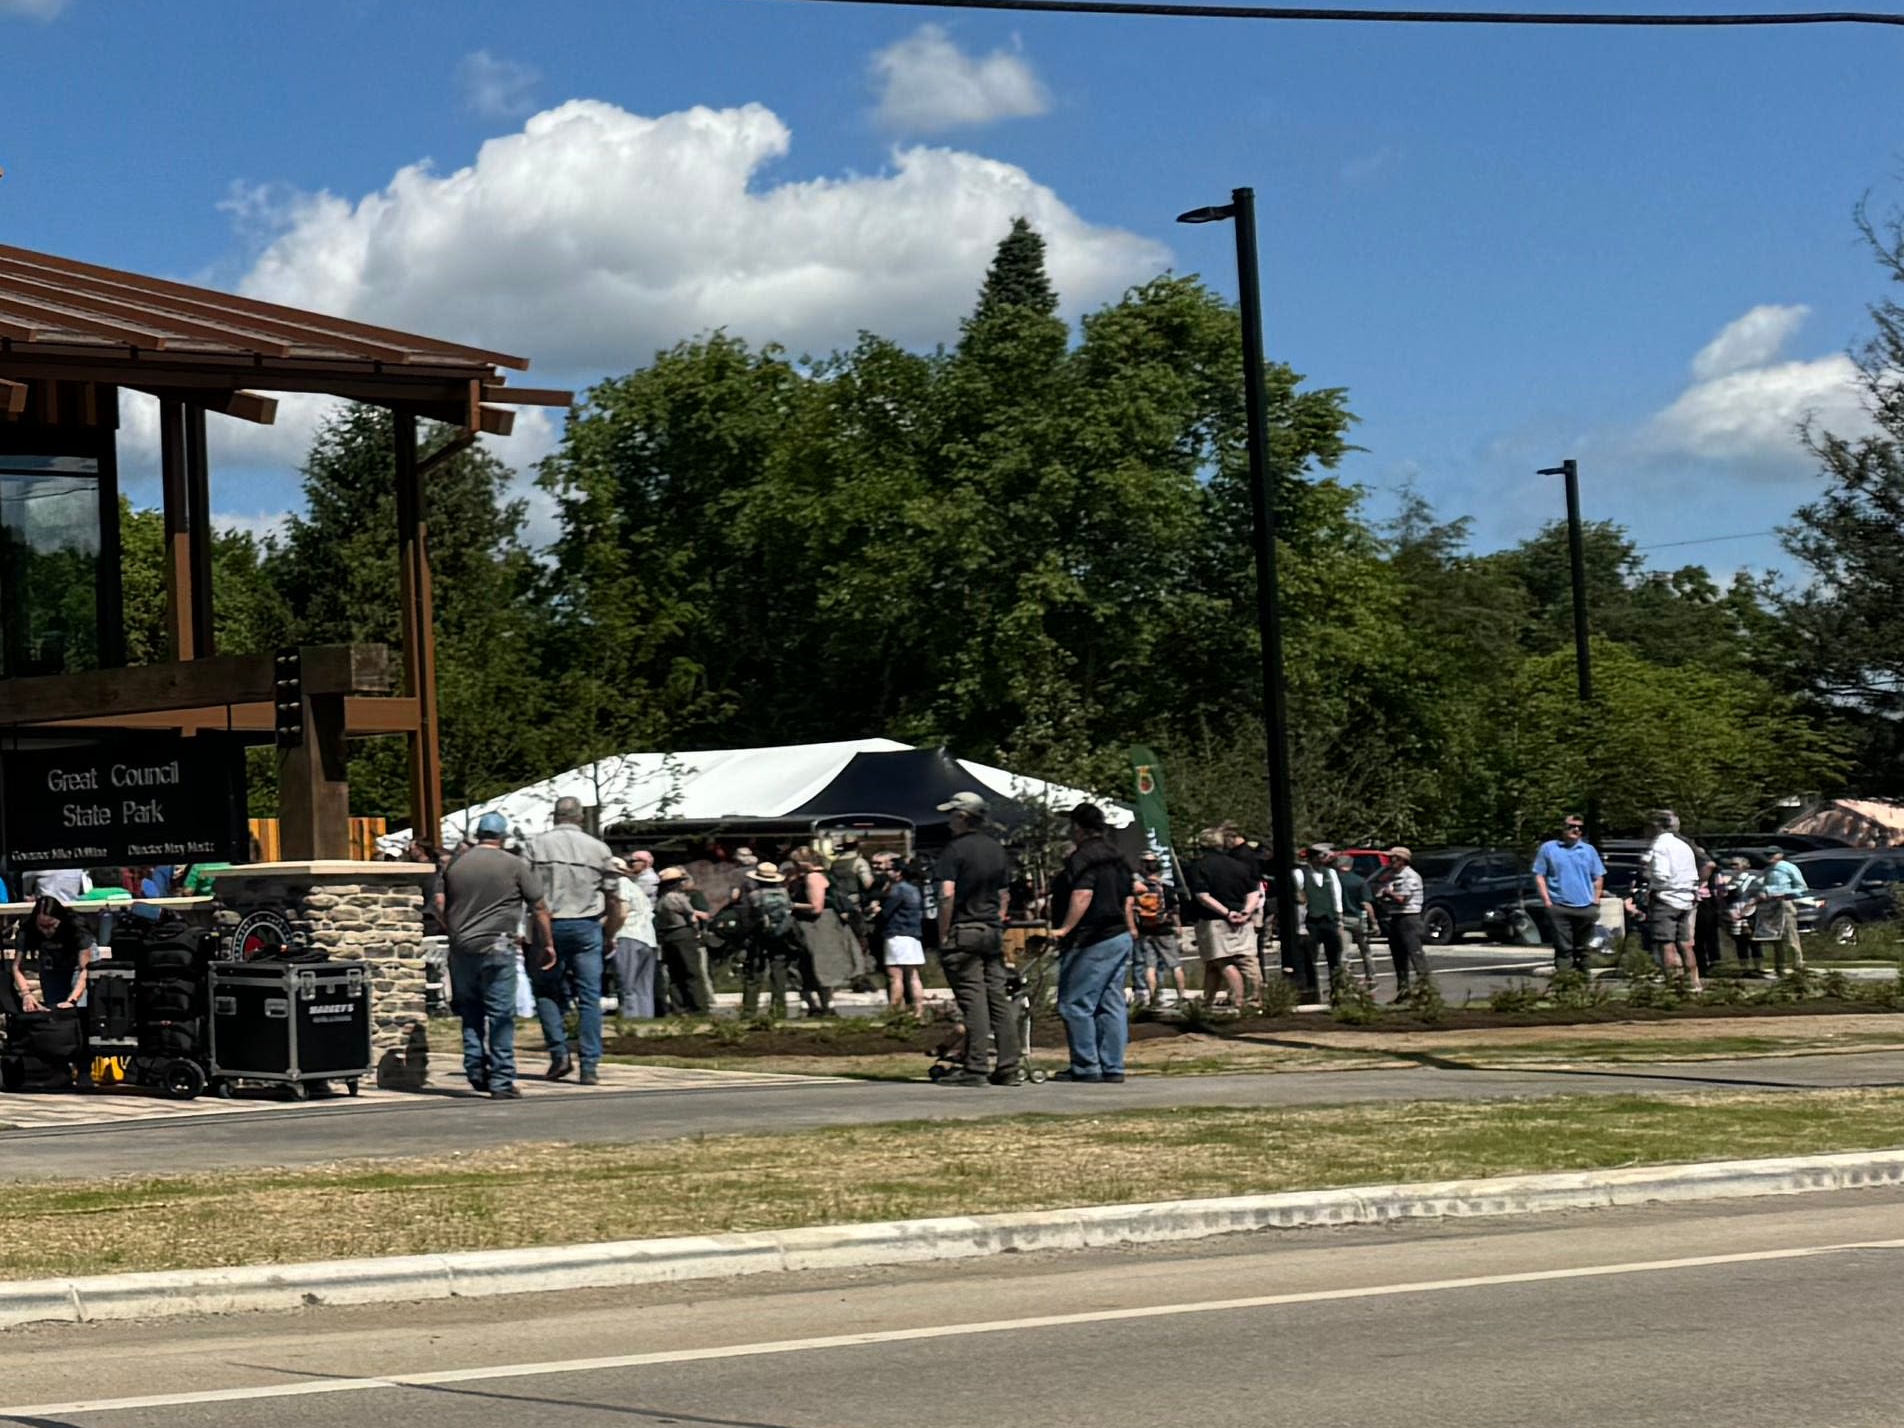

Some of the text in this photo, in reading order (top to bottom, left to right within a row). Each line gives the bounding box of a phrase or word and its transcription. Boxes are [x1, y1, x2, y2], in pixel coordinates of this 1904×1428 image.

[47, 760, 180, 792] Great Council
[63, 799, 165, 827] State Park
